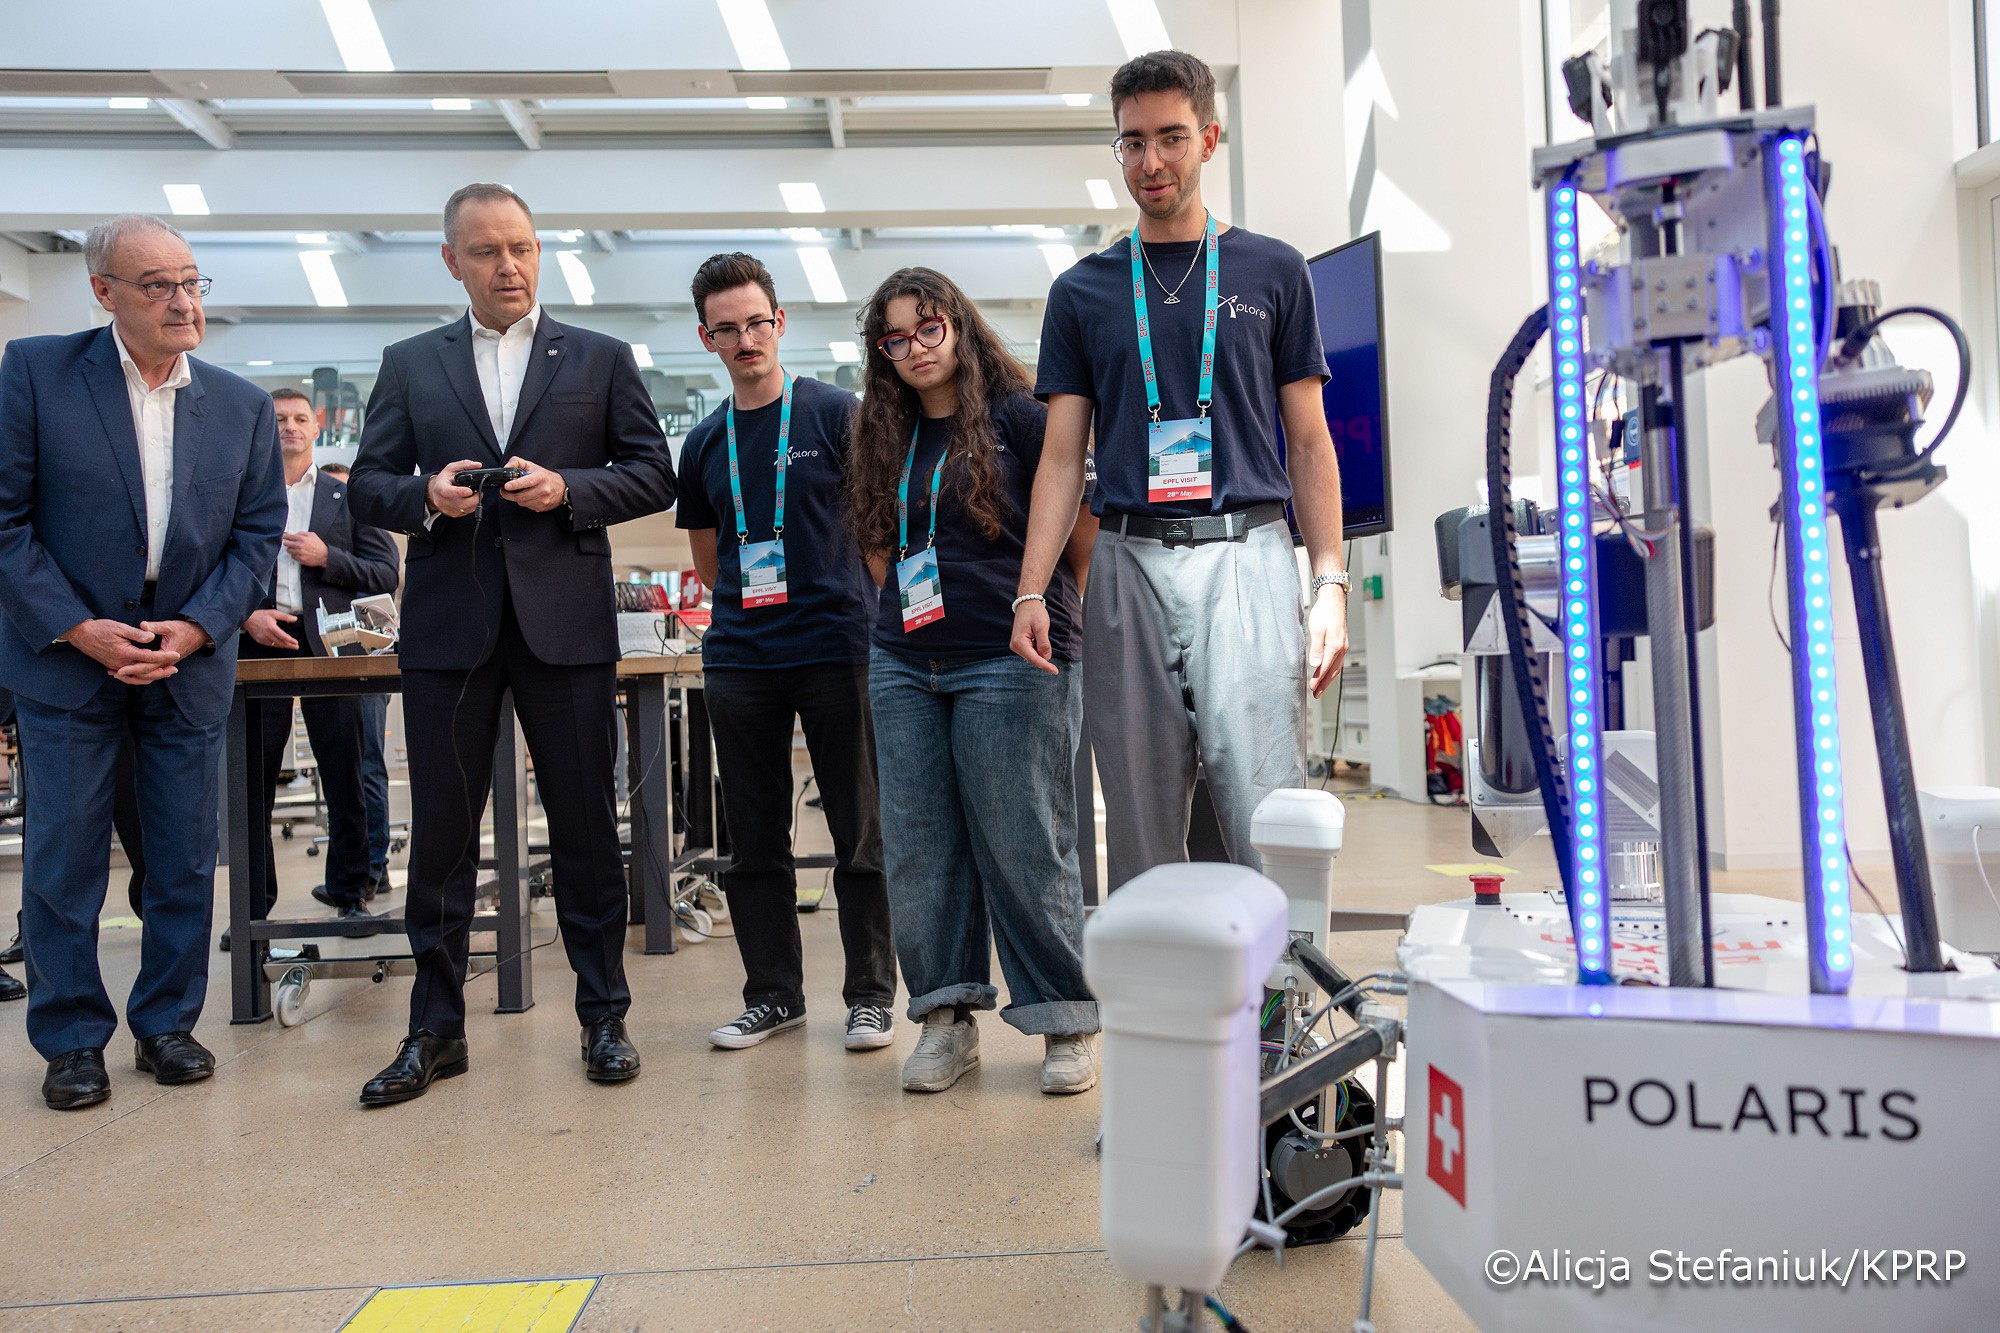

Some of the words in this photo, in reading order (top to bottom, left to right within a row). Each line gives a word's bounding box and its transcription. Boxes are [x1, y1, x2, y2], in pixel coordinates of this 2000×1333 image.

[1208, 233, 1217, 253] EPFL
[1134, 277, 1143, 299] EPFL
[1208, 270, 1217, 291] EPFL
[1138, 314, 1148, 338] EPFL
[1205, 309, 1215, 333] EPFL
[1143, 356, 1154, 383] EPFL
[1201, 353, 1212, 379] EPFL
[1180, 476, 1198, 484] VISIT
[1180, 490, 1193, 498] May
[1583, 1076, 1921, 1143] POLARIS
